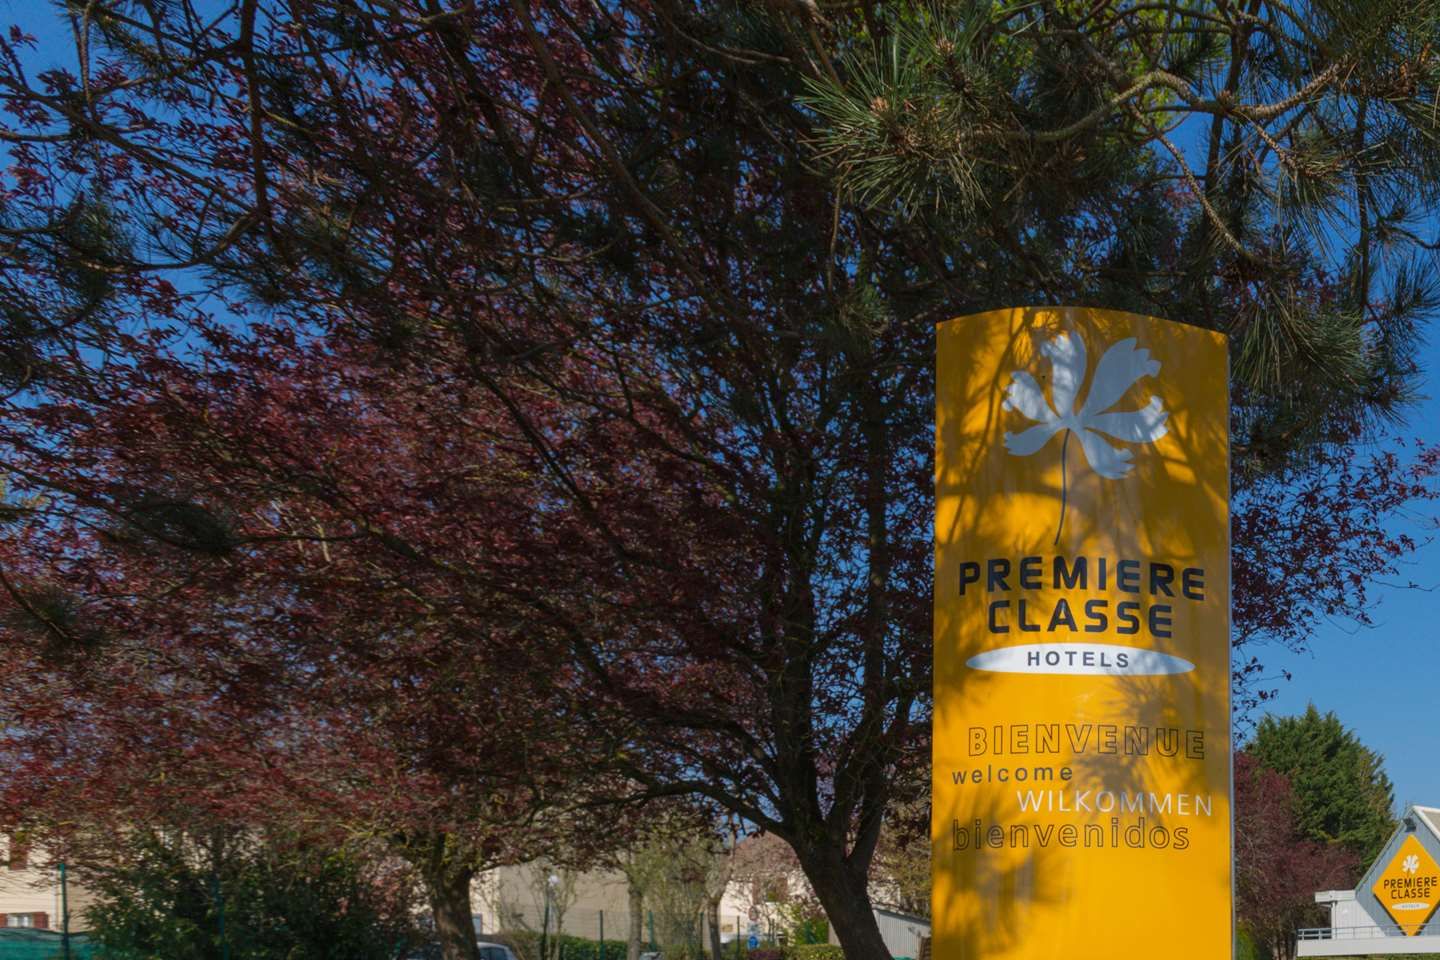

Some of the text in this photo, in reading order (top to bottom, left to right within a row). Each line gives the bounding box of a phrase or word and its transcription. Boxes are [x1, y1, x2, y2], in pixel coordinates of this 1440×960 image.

[959, 556, 1205, 600] PREMIERE
[988, 598, 1172, 638] CLASSE
[1027, 651, 1129, 667] HOTELS
[968, 723, 1205, 760] BIENVENUE
[952, 764, 1073, 784] welcome
[1017, 790, 1212, 817] WILKOMMEN
[953, 817, 1190, 850] bienvenidos
[1383, 876, 1438, 890] PREMIERE
[1391, 887, 1431, 899] CLASSE
